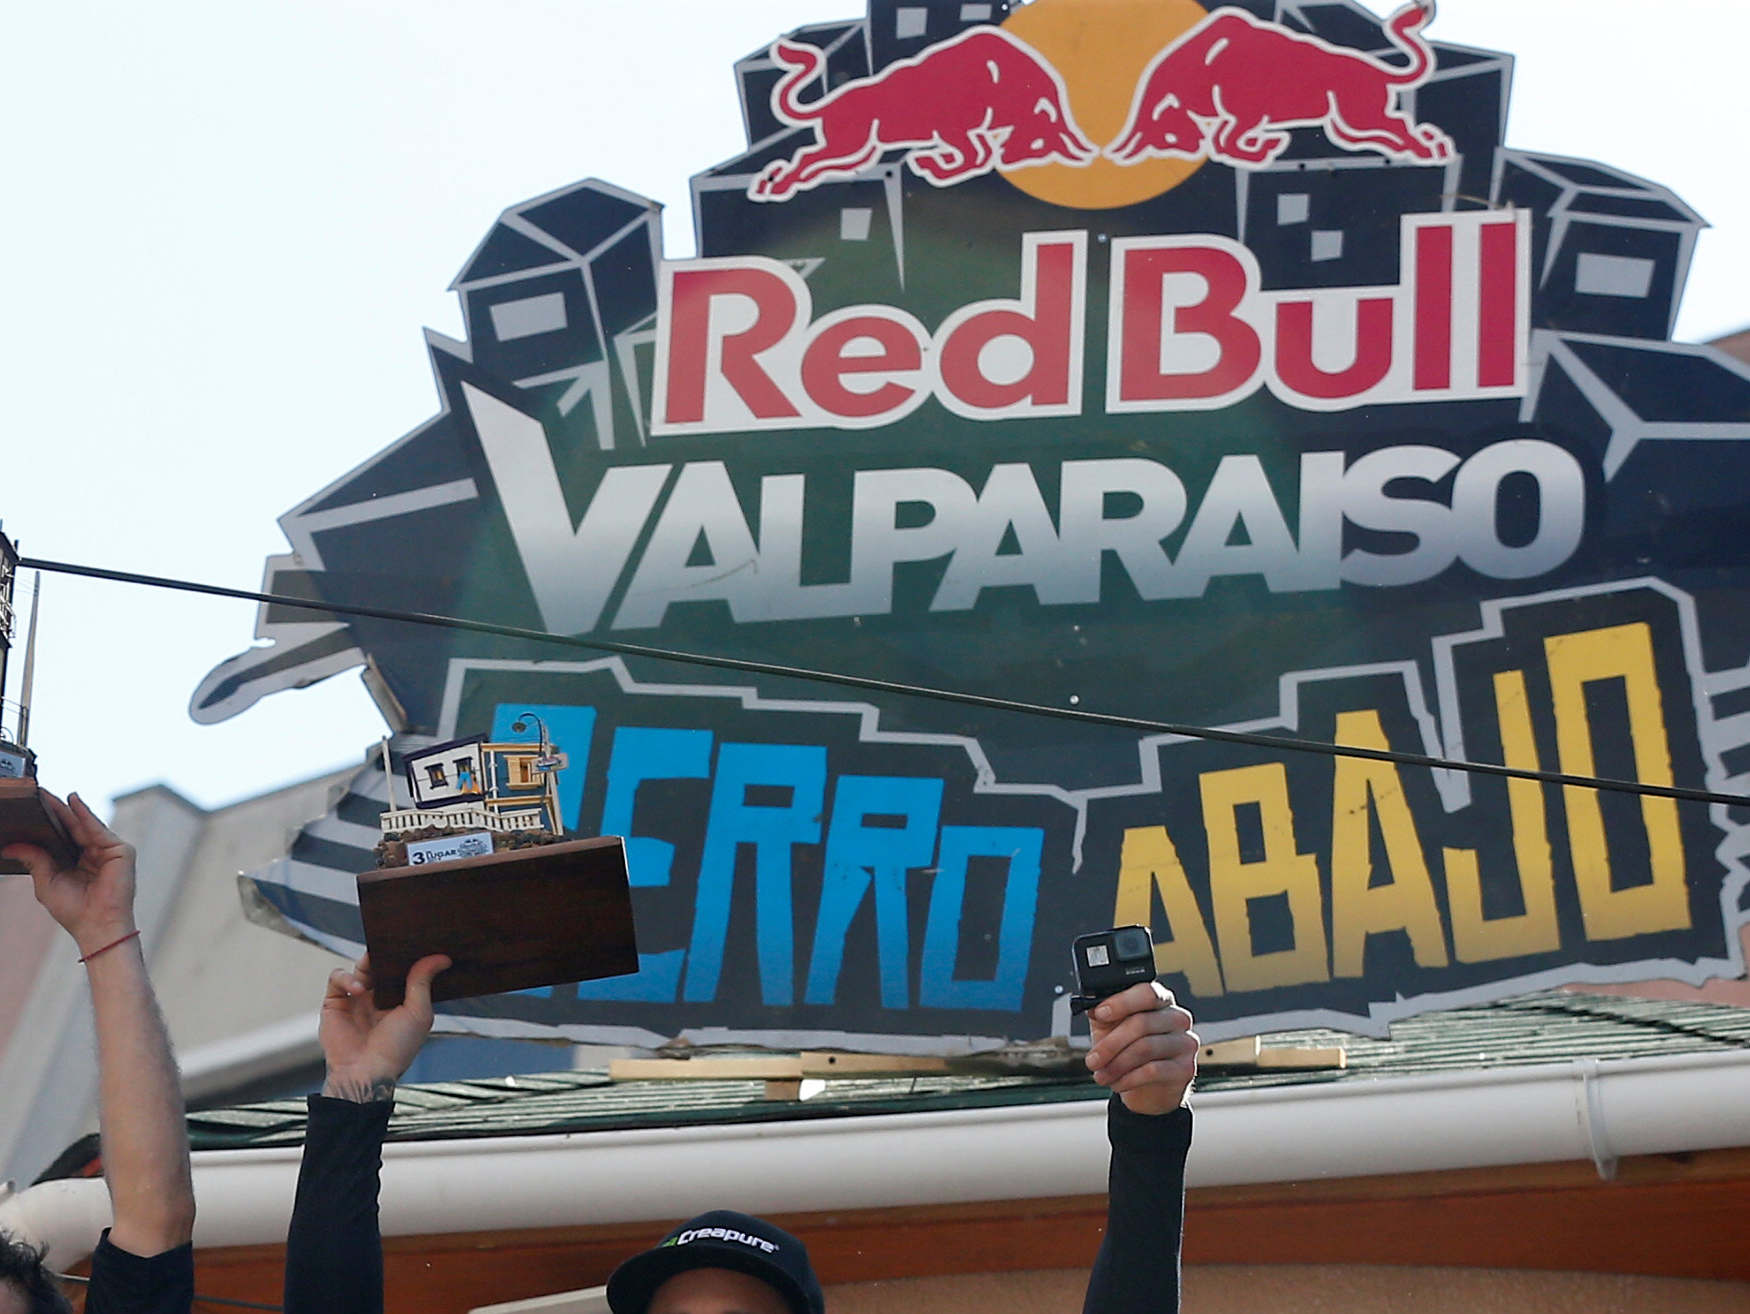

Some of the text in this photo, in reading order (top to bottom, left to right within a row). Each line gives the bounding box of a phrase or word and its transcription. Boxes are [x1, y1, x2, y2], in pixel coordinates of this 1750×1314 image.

[662, 221, 1518, 426] Red Bull
[462, 380, 1585, 638] VALPARAISO
[1112, 622, 1692, 997] ABAJO
[677, 1227, 774, 1253] Creapure
